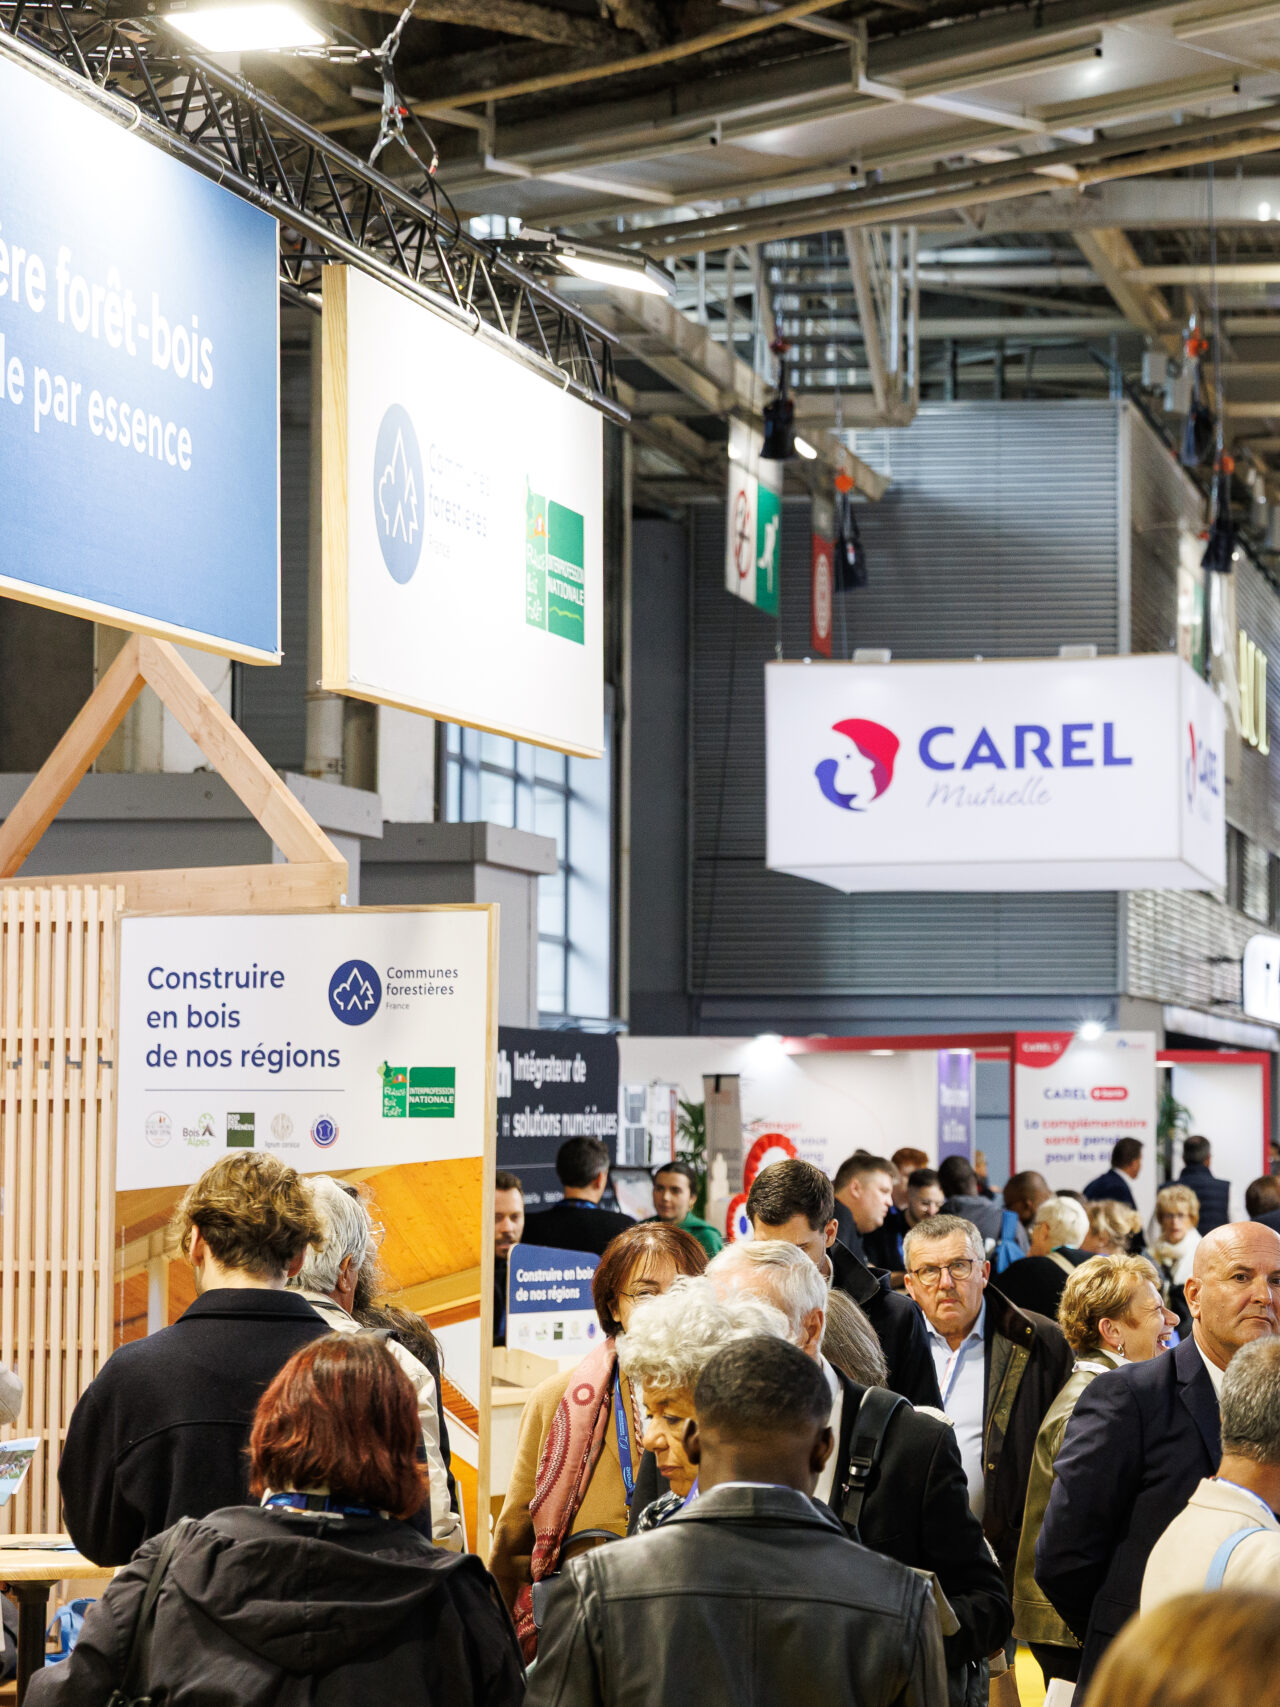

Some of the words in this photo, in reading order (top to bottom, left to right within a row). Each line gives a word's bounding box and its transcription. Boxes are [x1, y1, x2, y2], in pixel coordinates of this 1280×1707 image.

[56, 245, 213, 389] forêt-bois
[34, 366, 81, 433] par
[88, 390, 192, 471] essence
[548, 575, 585, 607] NATIONALE
[918, 722, 1134, 772] CAREL
[926, 775, 1052, 808] Mutuelle
[148, 963, 285, 990] Construire
[387, 966, 458, 979] Communes
[386, 982, 454, 996] forestières
[146, 1010, 177, 1029] en
[187, 1003, 241, 1029] bois
[146, 1044, 177, 1068] de
[187, 1049, 233, 1068] nos
[241, 1042, 341, 1074] régions
[513, 1049, 571, 1090] Intégrateur
[572, 1052, 587, 1083] de
[513, 1104, 560, 1138] solutions
[561, 1104, 618, 1141] numériques
[516, 1268, 562, 1283] Construire
[563, 1269, 576, 1281] en
[515, 1287, 526, 1302] de
[529, 1288, 547, 1300] nos
[547, 1285, 580, 1303] régions
